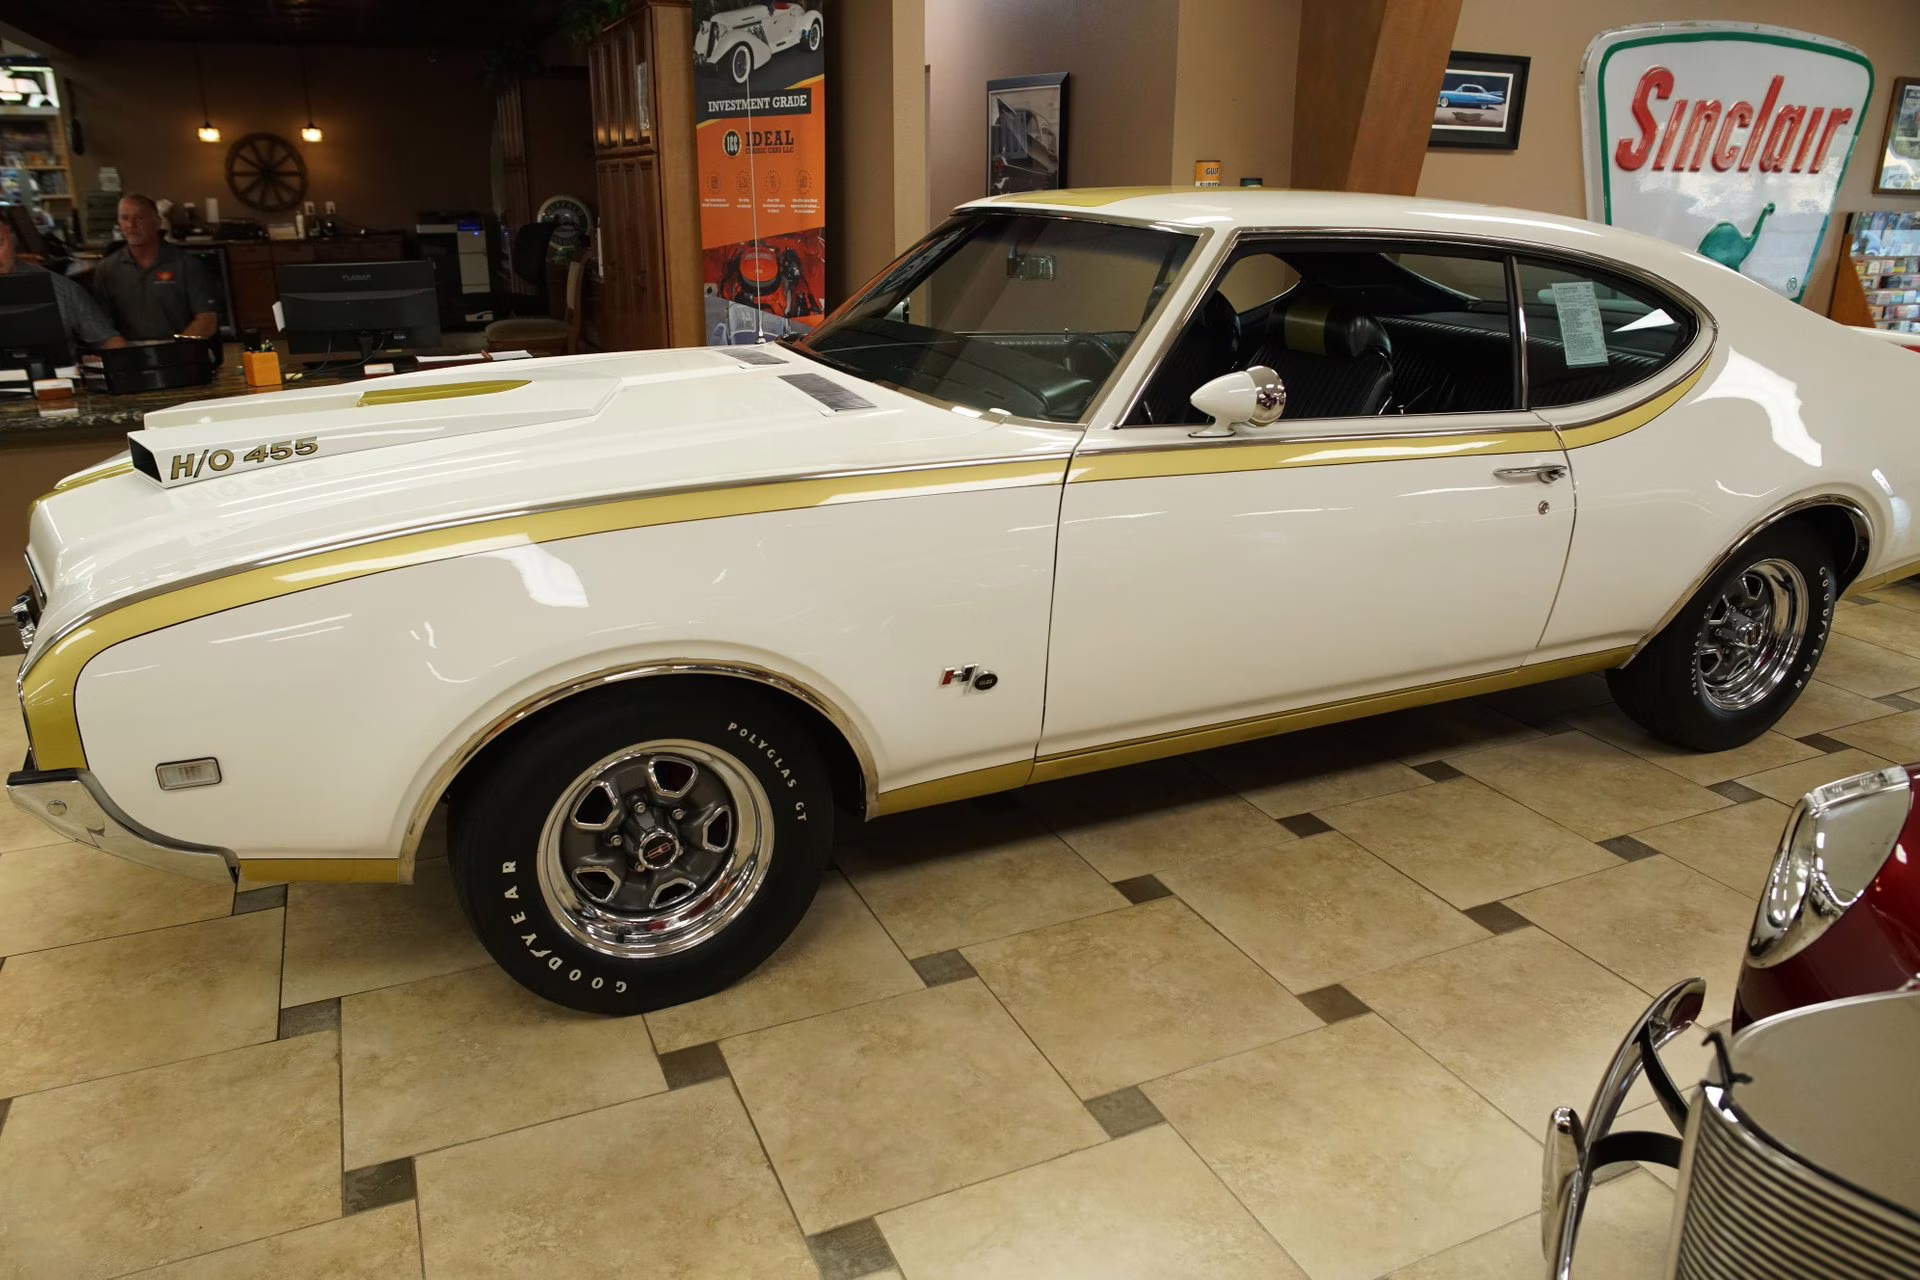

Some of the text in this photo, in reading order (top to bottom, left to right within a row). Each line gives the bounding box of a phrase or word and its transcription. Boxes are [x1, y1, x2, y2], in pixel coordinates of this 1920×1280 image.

[708, 95, 807, 112] INVESTMENT GRADE
[745, 130, 794, 147] IDEAL
[1615, 65, 1854, 174] Sinclair
[170, 435, 319, 481] H/O 455
[1794, 566, 1830, 689] GOODYEAR
[727, 722, 807, 821] POLYGLAS GT
[502, 860, 628, 993] GOODYEAR
